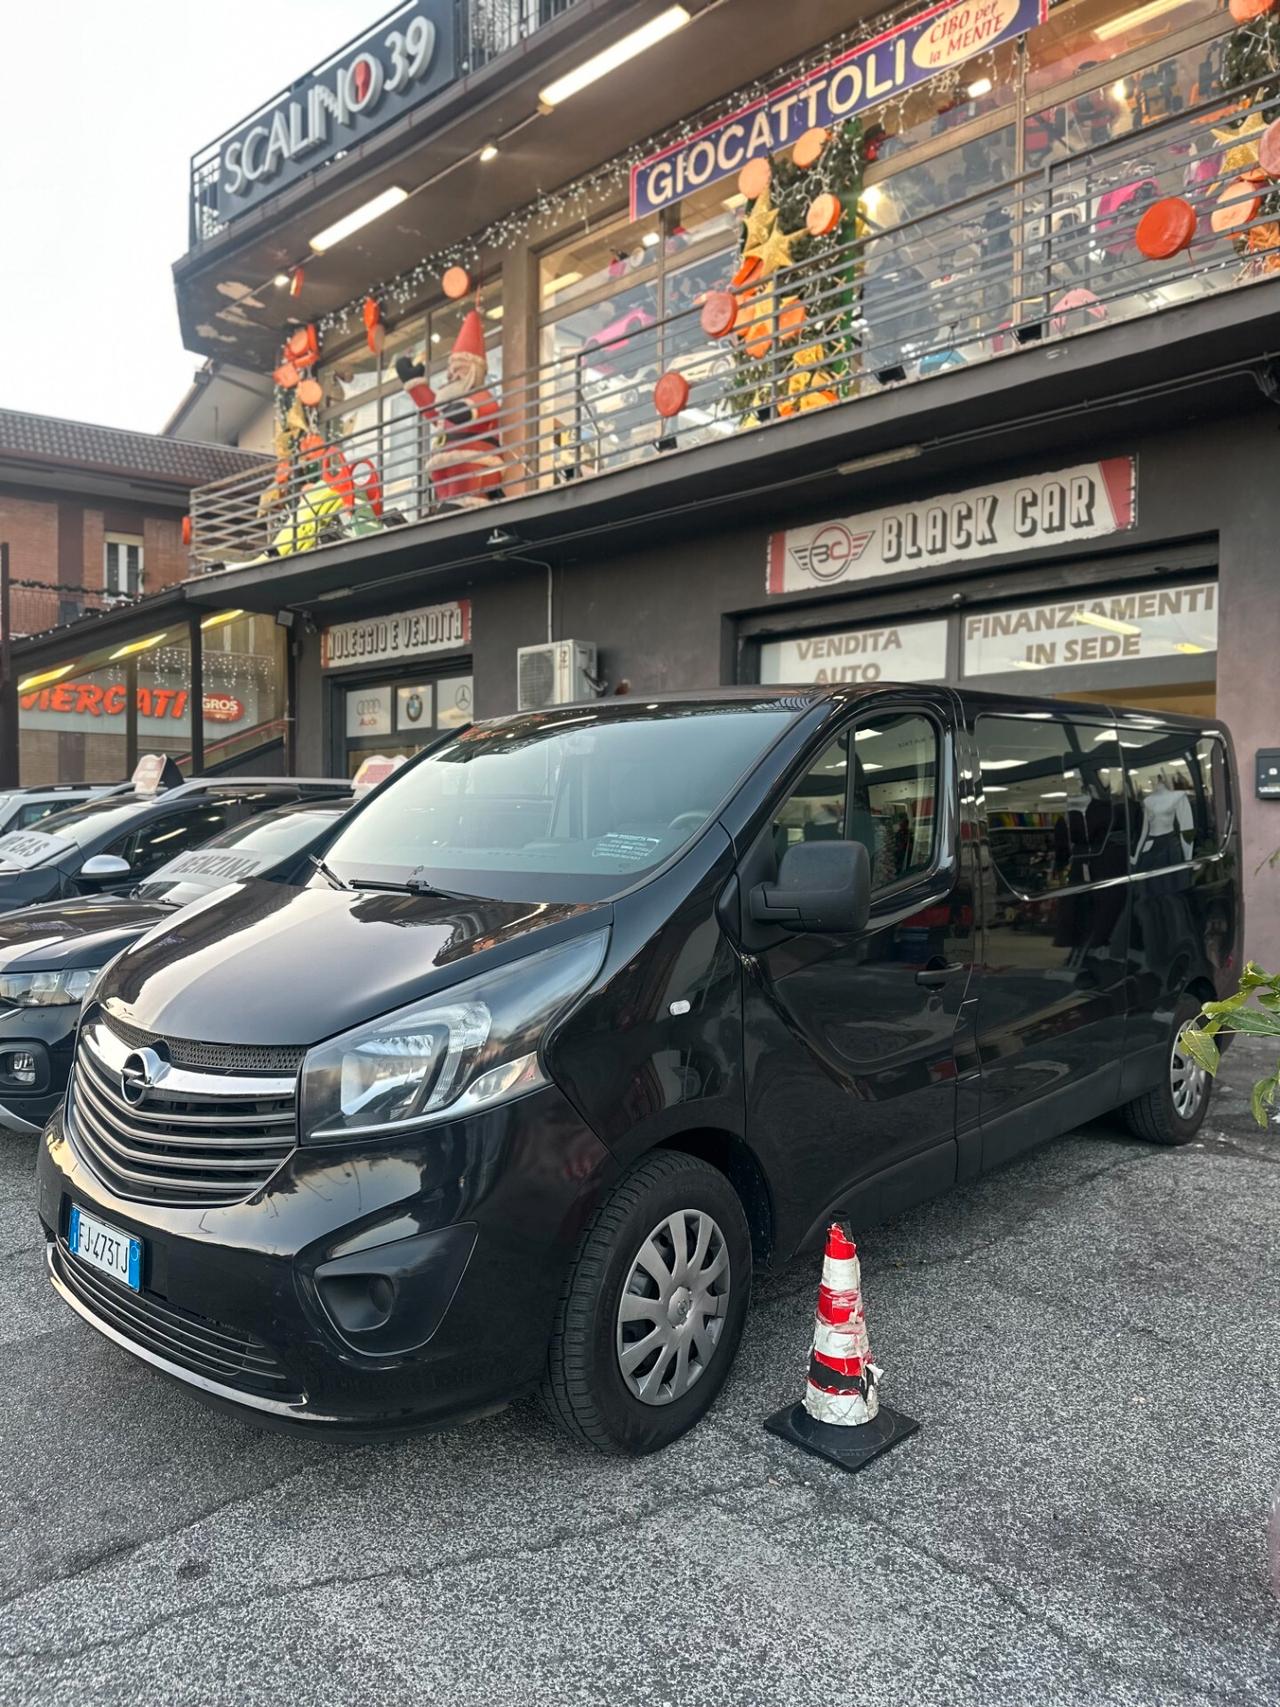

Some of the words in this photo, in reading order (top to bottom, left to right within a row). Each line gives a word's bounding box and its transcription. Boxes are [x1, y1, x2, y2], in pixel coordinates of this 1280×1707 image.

[929, 10, 970, 43] CIBO
[975, 0, 998, 25] per
[947, 12, 1004, 56] MENTE
[224, 52, 383, 195] SCALINO
[384, 15, 436, 92] 39
[646, 39, 906, 206] GIOCATTOLI
[881, 495, 998, 564] BLACK
[1013, 475, 1096, 535] CAR
[328, 622, 387, 661] NOLEGGIO
[391, 620, 399, 650] E
[402, 608, 463, 648] VENDITA
[967, 586, 1214, 640] FINANZIAMENTI
[795, 629, 903, 660] VENDITA
[1026, 643, 1056, 665] IN
[1064, 632, 1142, 662] SEDE
[815, 662, 882, 685] AUTO
[202, 698, 239, 710] GROS
